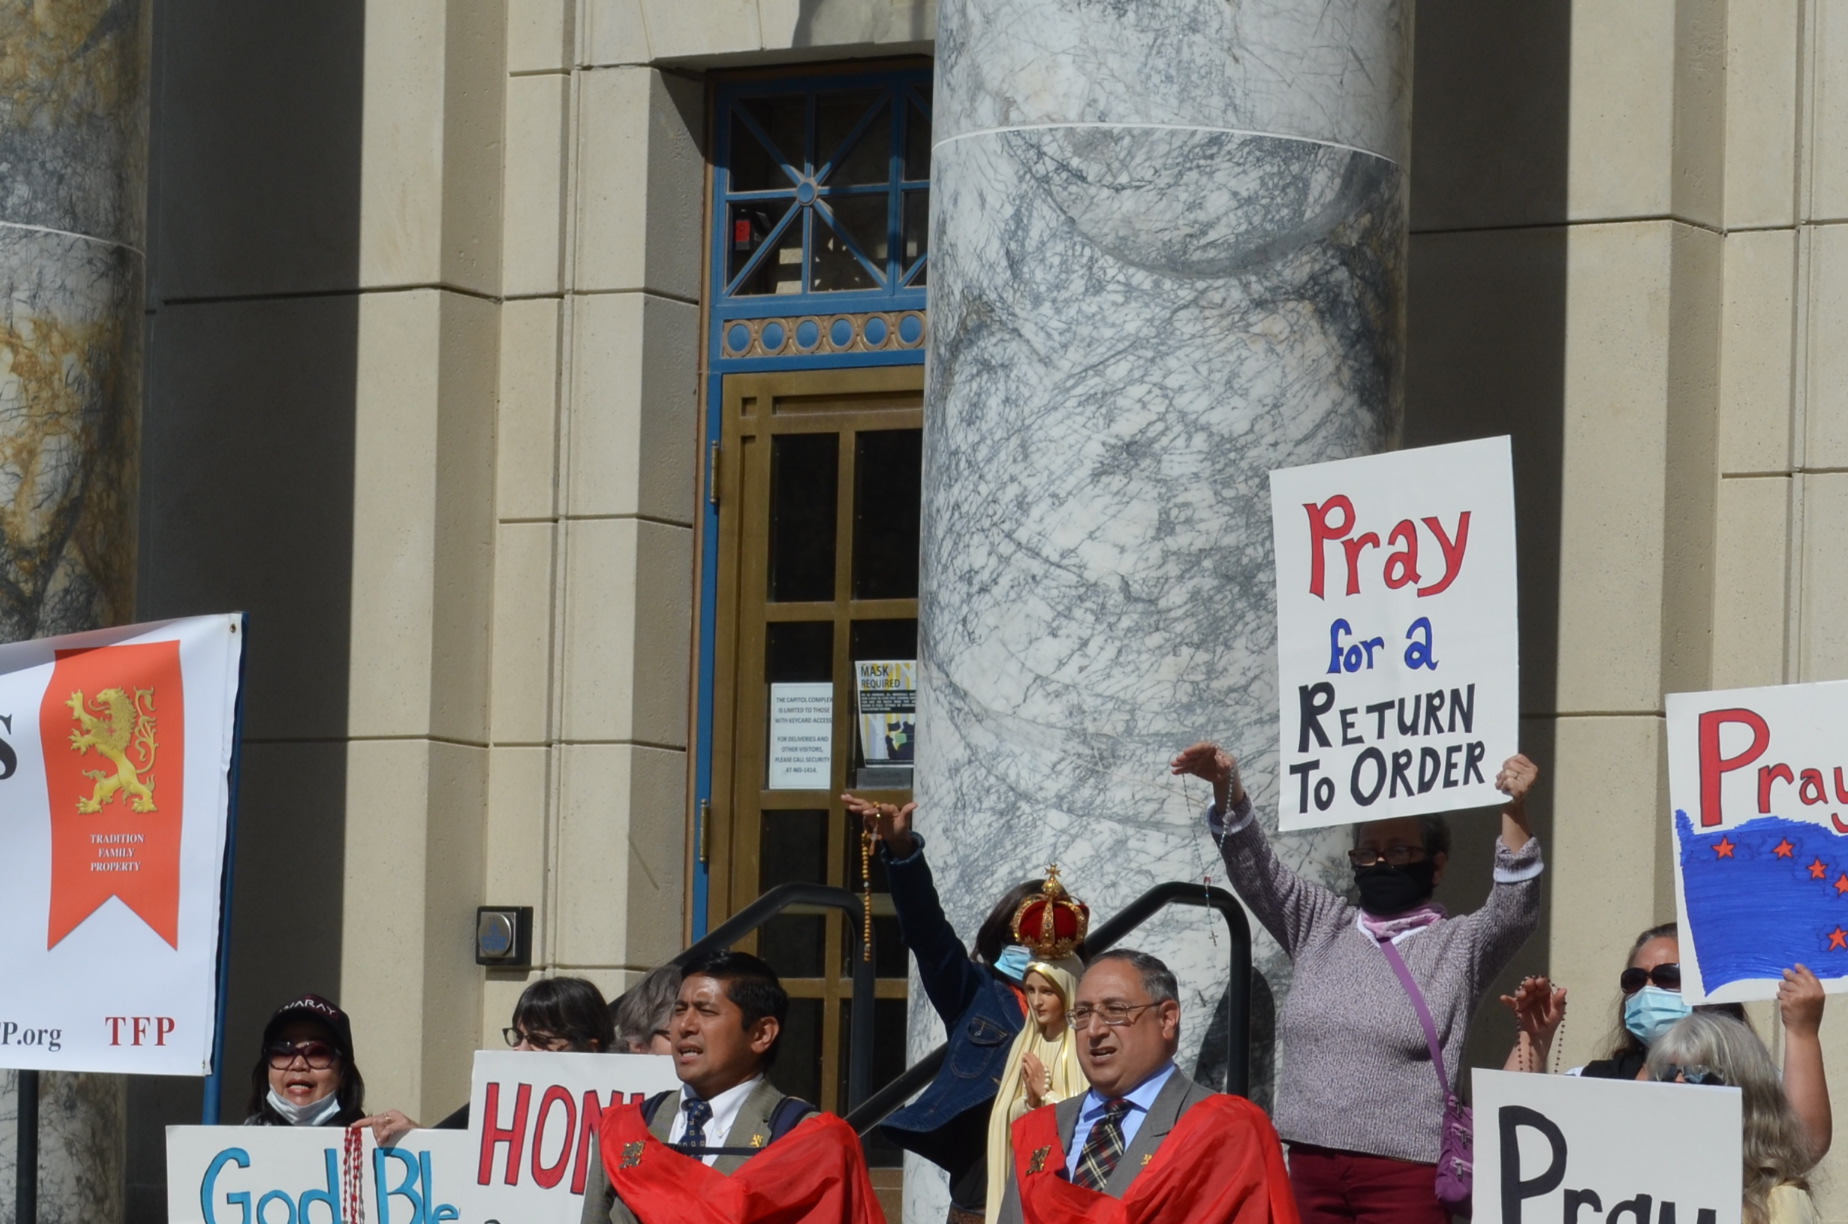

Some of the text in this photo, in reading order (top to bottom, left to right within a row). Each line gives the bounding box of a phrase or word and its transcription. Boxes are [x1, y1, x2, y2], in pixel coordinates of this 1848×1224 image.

[1303, 494, 1471, 600] Pray
[1326, 617, 1439, 674] for a
[861, 666, 889, 676] MASK
[861, 679, 901, 688] REQUIRED
[1298, 681, 1475, 753] RETURN
[1350, 740, 1485, 806] ORDER
[90, 834, 144, 844] TRADITION
[99, 848, 134, 858] FAMILY
[91, 862, 141, 872] PROPERTY
[0, 1021, 62, 1052] P.org
[105, 1016, 176, 1046] TFP
[477, 1082, 646, 1195] HON
